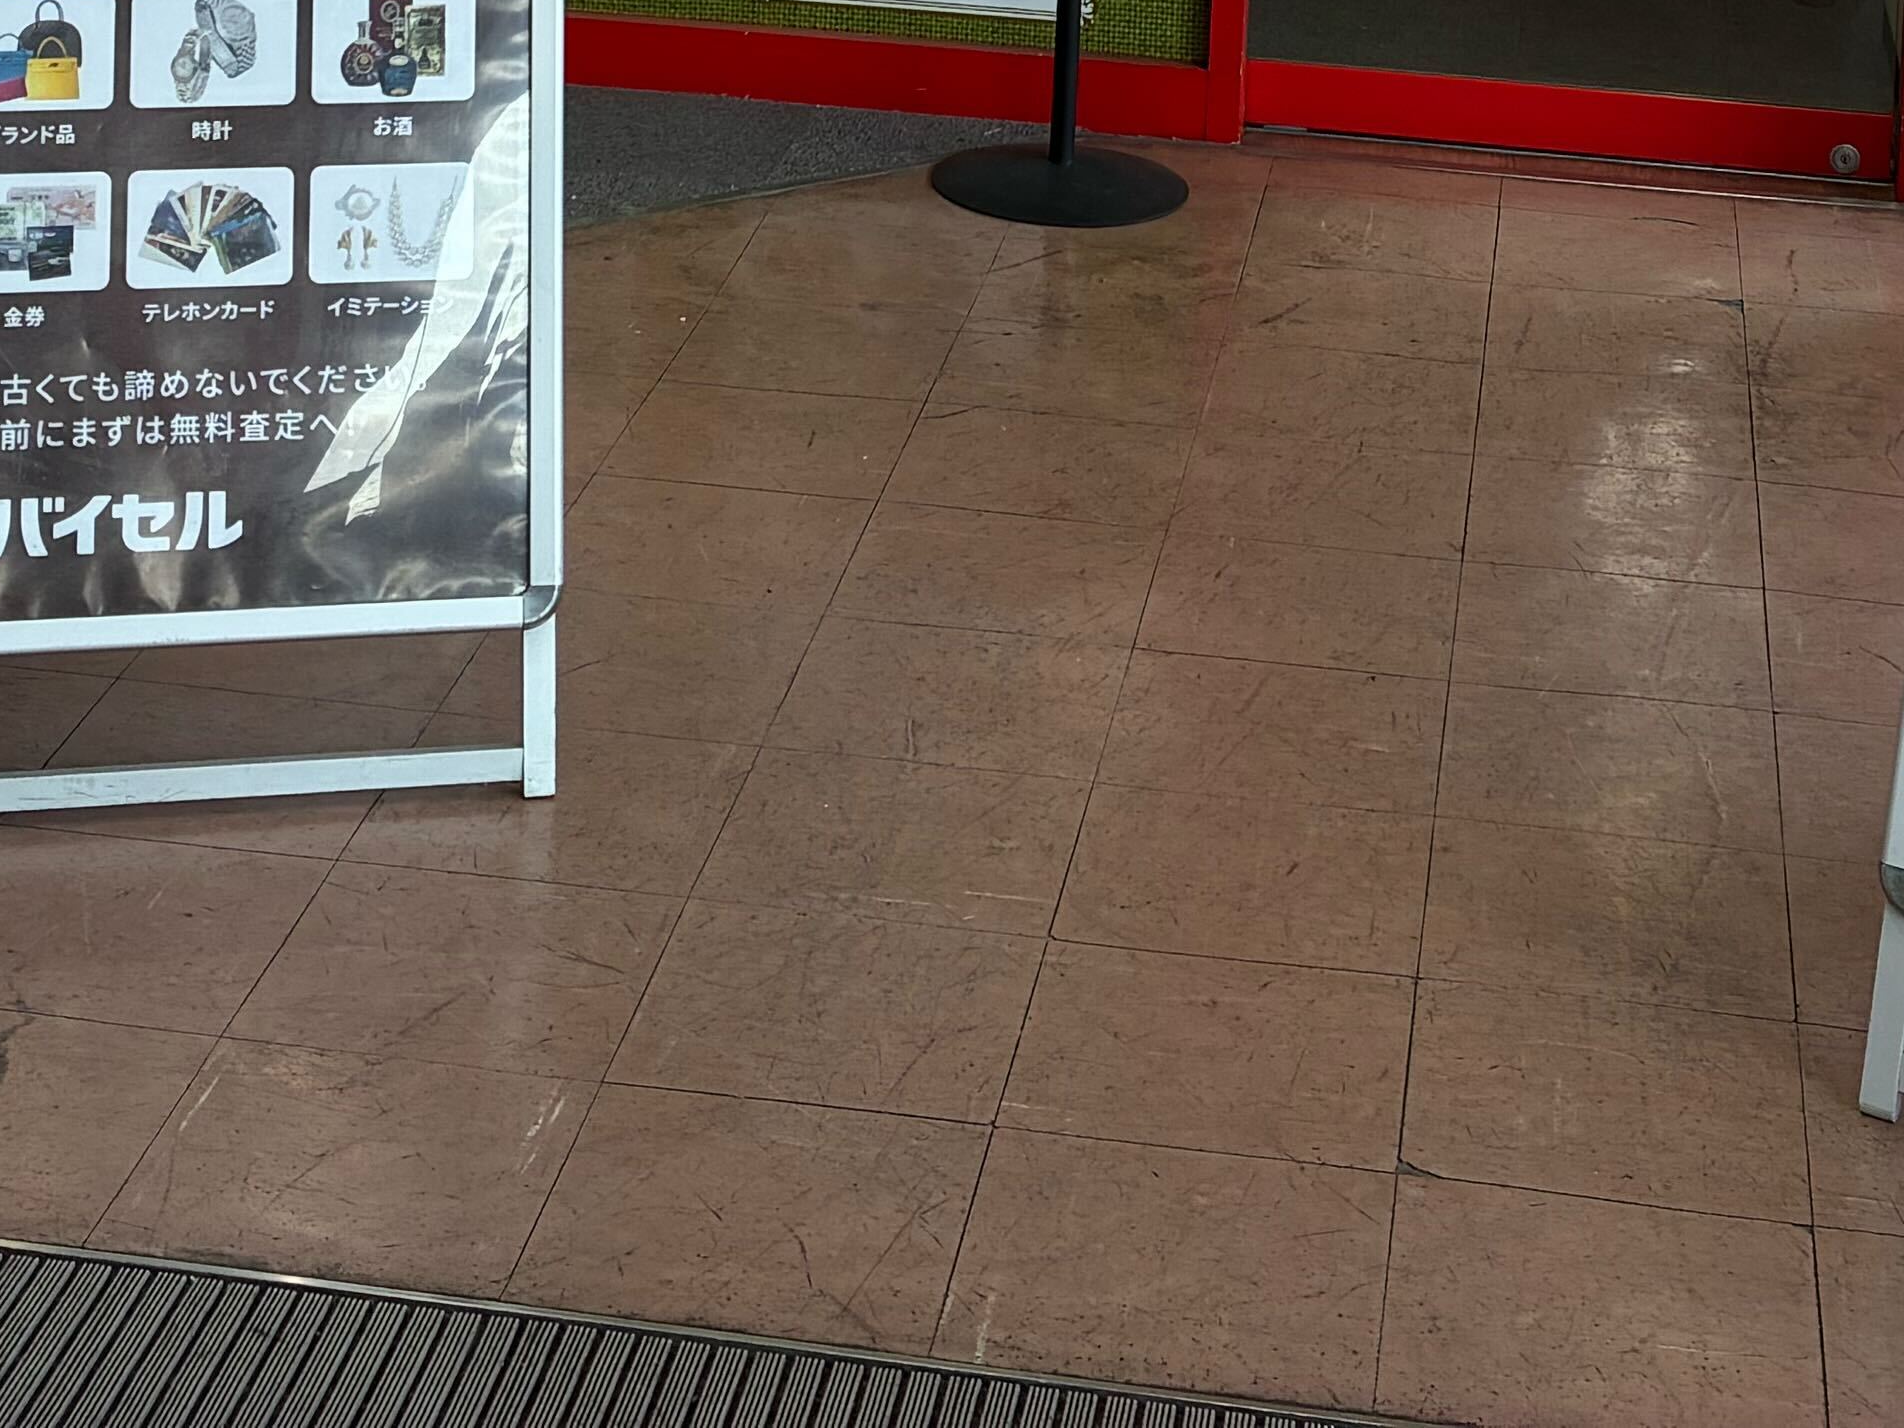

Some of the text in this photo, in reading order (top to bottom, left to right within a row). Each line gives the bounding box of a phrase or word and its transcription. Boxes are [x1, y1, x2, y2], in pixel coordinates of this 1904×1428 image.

[191, 120, 231, 141] 時計
[373, 116, 413, 138] お酒
[3, 307, 44, 329] 金券
[142, 299, 274, 323] テレホンカード
